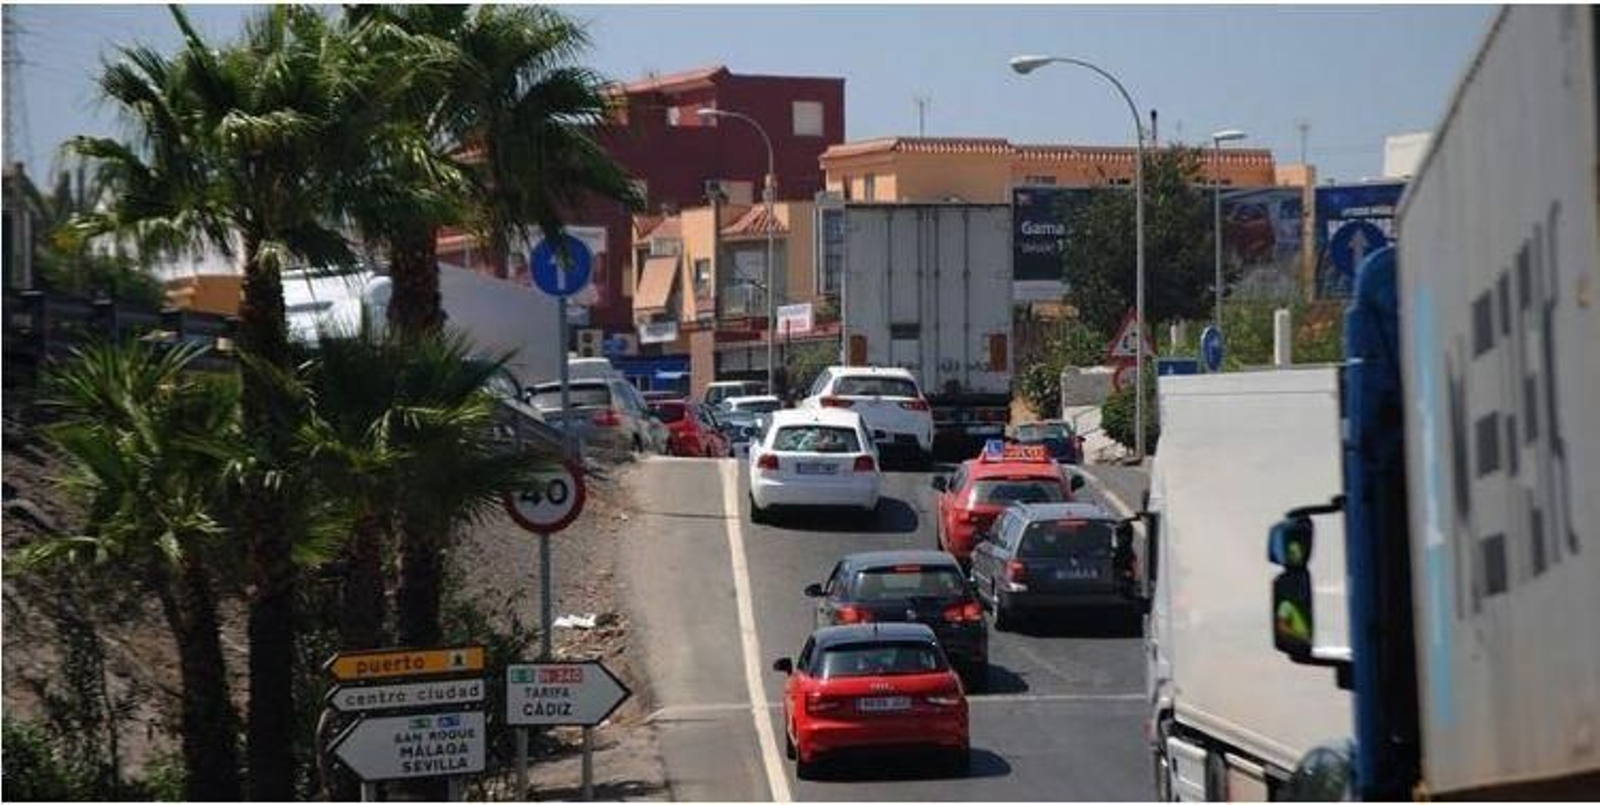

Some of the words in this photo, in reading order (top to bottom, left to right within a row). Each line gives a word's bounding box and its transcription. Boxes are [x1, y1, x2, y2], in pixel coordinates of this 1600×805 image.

[1021, 220, 1065, 236] Gama
[520, 478, 569, 506] 40
[356, 655, 426, 675] puerto
[345, 690, 406, 707] centro
[416, 684, 480, 701] ciudad
[524, 686, 571, 699] TARIFA
[522, 700, 574, 717] CÁDIZ
[394, 731, 423, 744] SAN
[429, 728, 476, 741] ROQUE
[401, 742, 469, 758] MÁLAGA
[401, 757, 469, 773] SEVILLA
